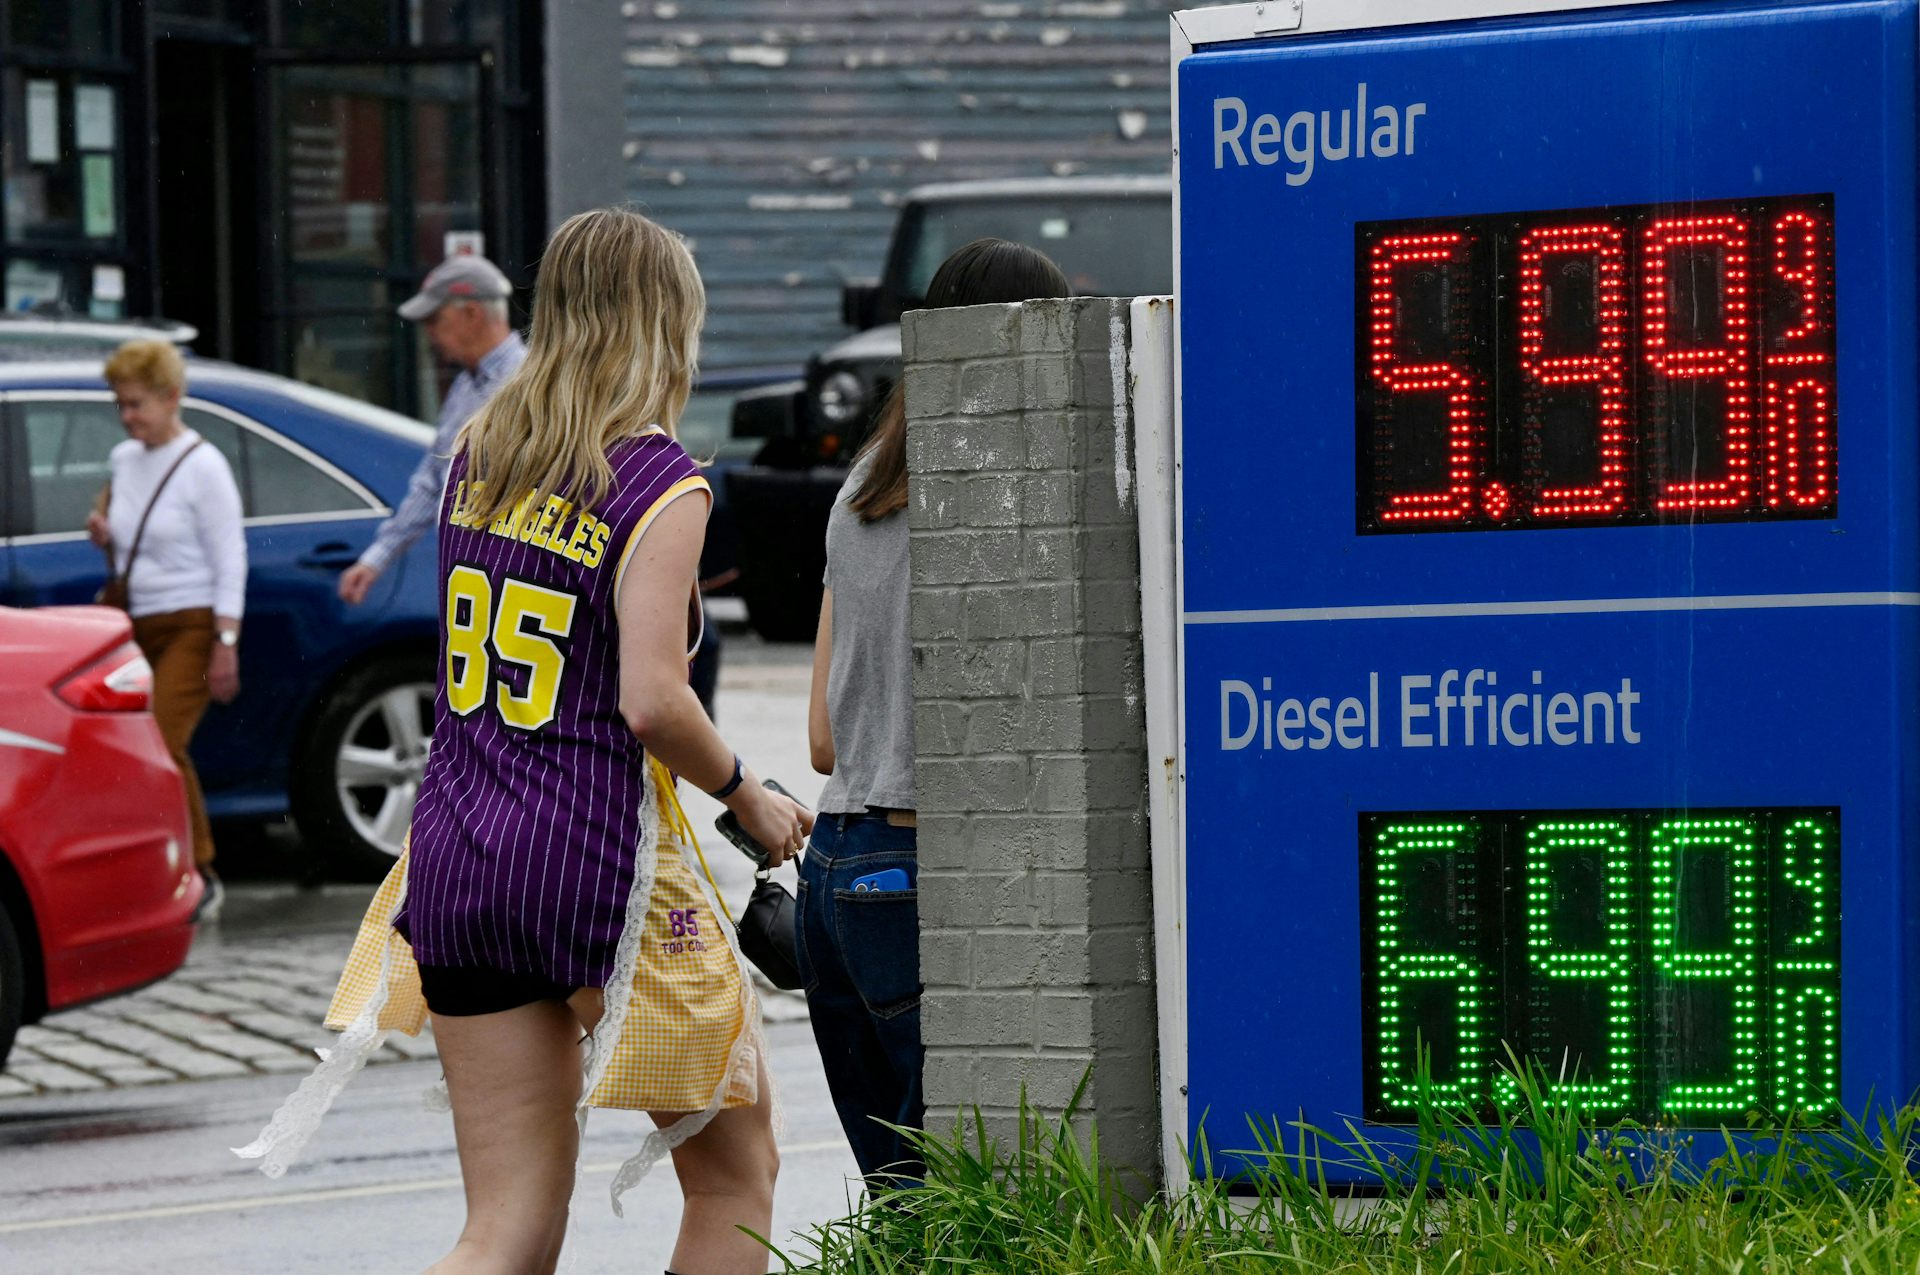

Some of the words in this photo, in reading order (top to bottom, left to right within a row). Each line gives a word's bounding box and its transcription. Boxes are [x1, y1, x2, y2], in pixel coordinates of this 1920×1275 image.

[1213, 82, 1427, 187] Regular
[1371, 214, 1749, 520] 5.99
[449, 480, 488, 529] LO
[446, 564, 578, 731] 85
[1220, 671, 1380, 751] Diesel
[1400, 668, 1641, 748] Efficient
[662, 943, 683, 953] TOO
[670, 909, 698, 936] 85
[1377, 820, 1755, 1109] 6.99
